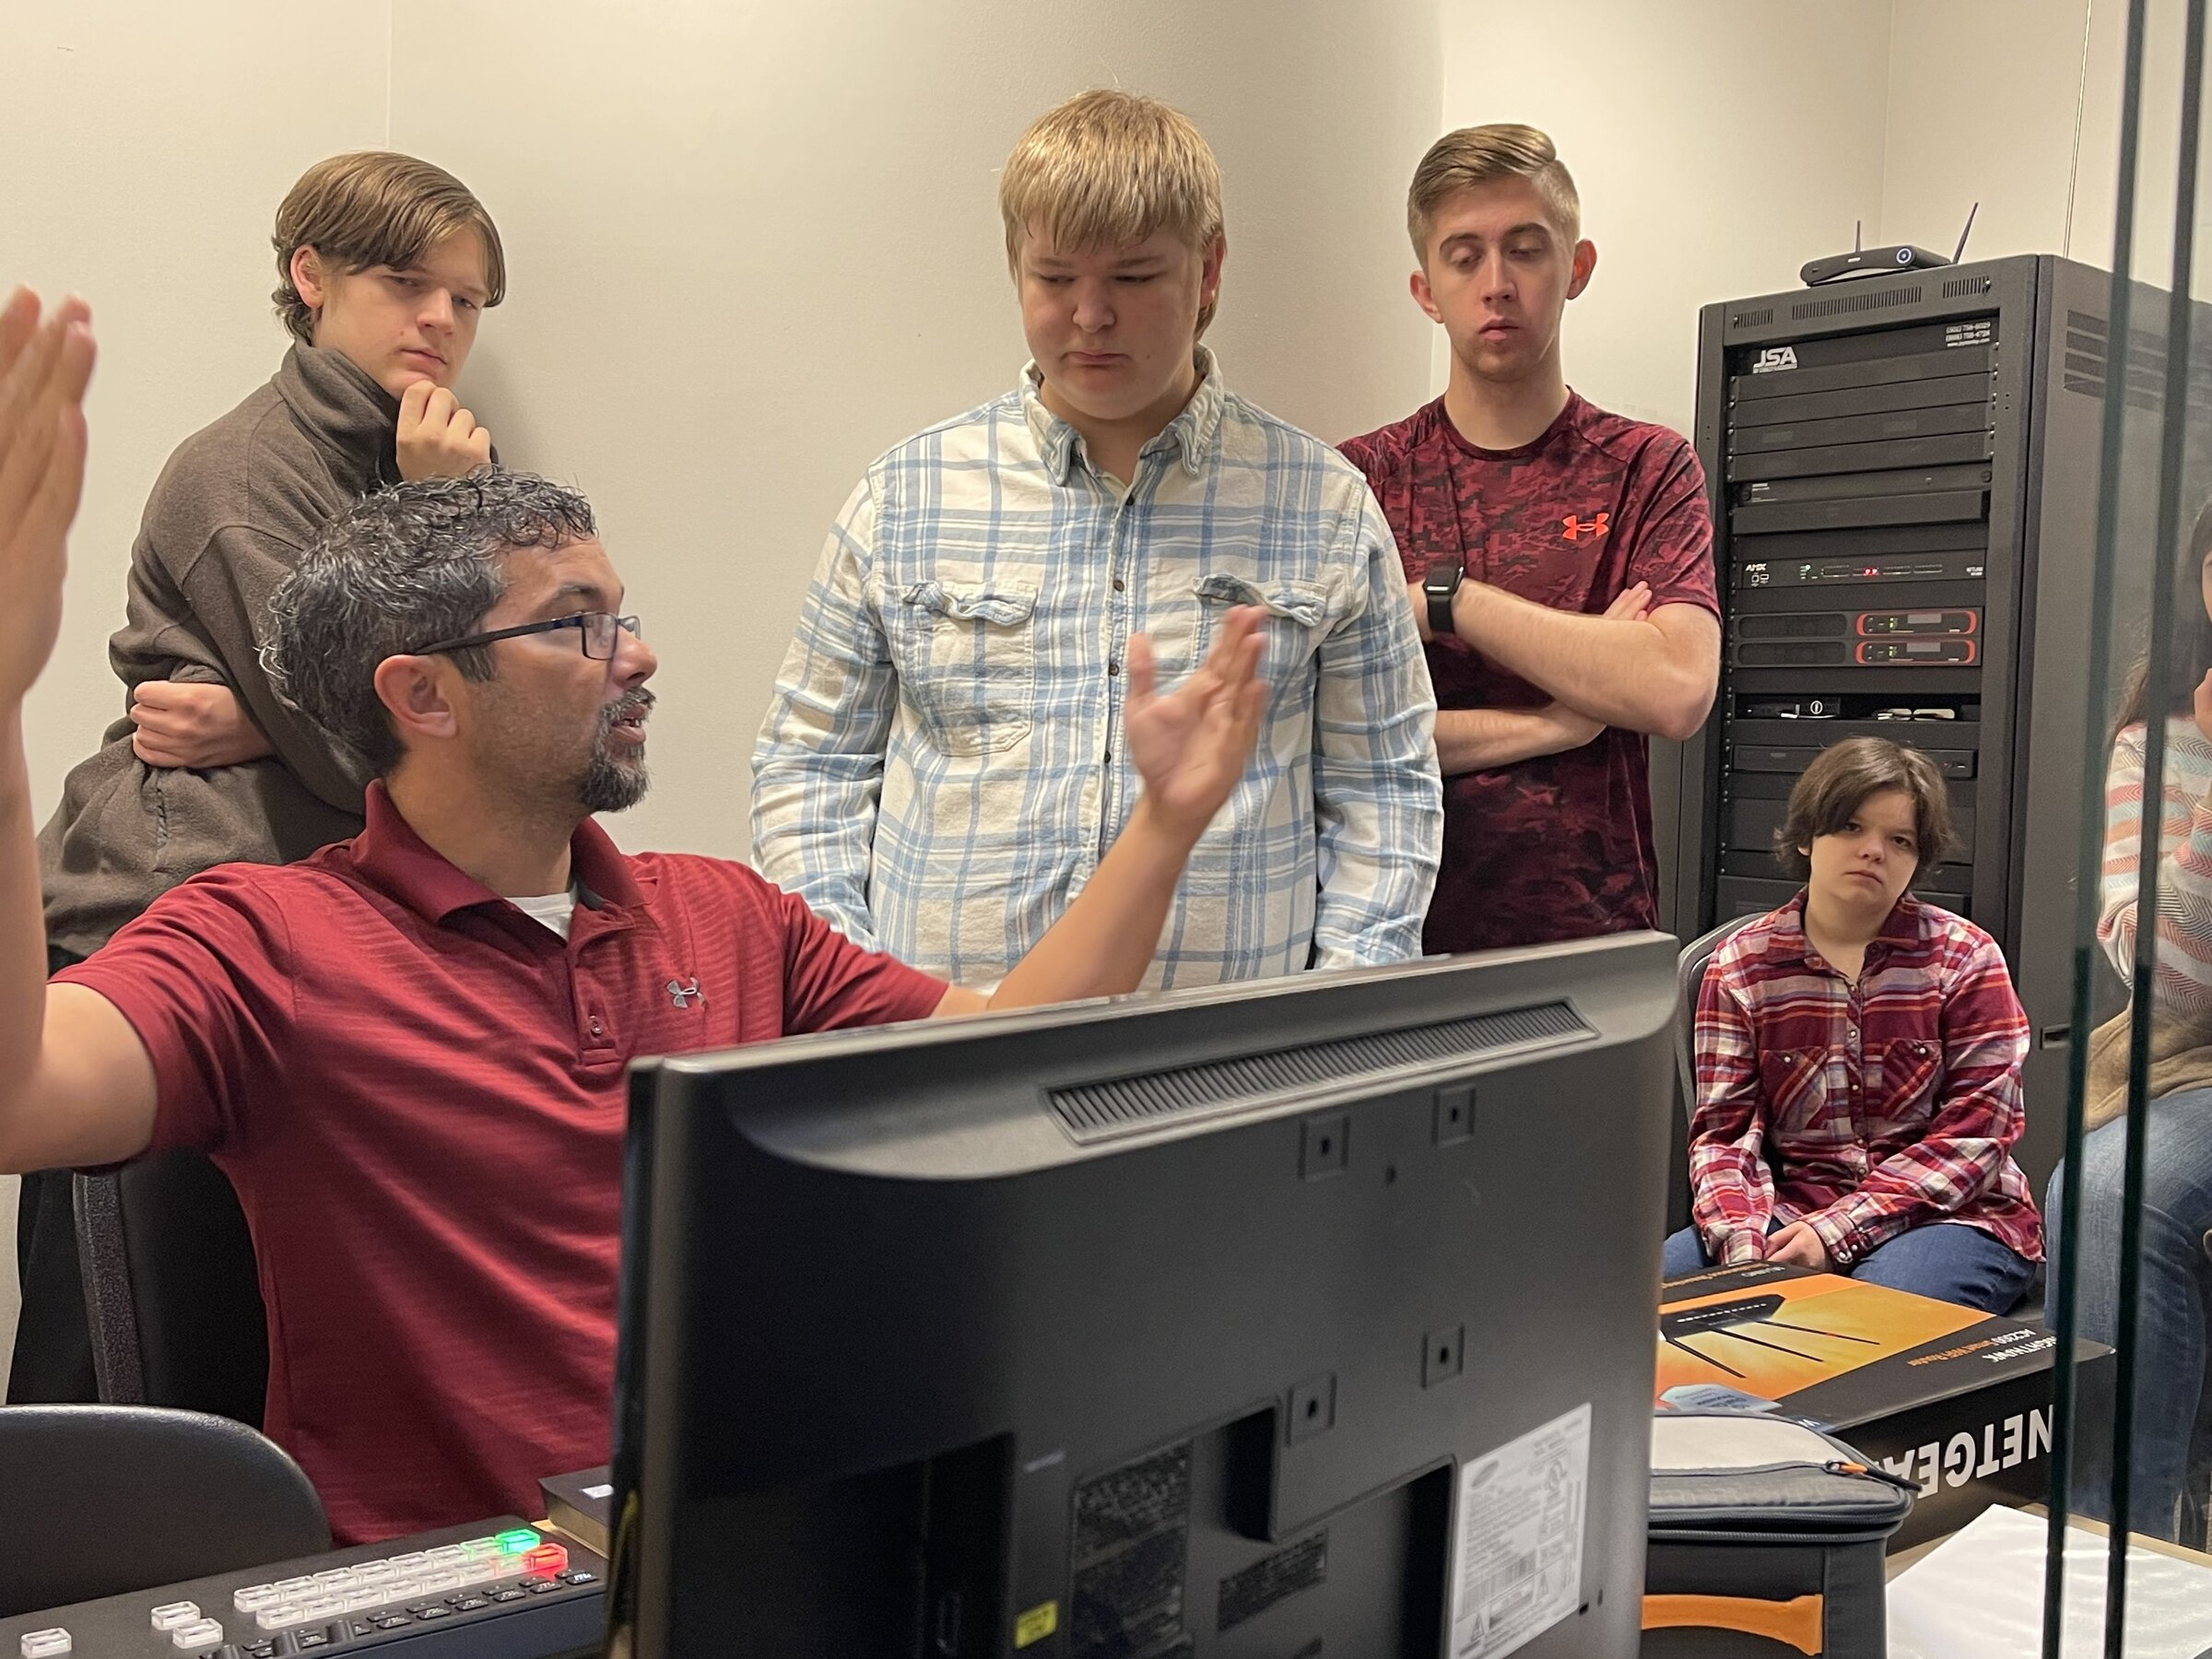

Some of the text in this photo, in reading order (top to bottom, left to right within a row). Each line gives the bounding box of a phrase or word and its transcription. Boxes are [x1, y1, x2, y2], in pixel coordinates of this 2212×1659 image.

[1753, 347, 1797, 369] JSA
[1745, 563, 1767, 571] AMX
[1875, 1405, 2053, 1500] NETGEA
